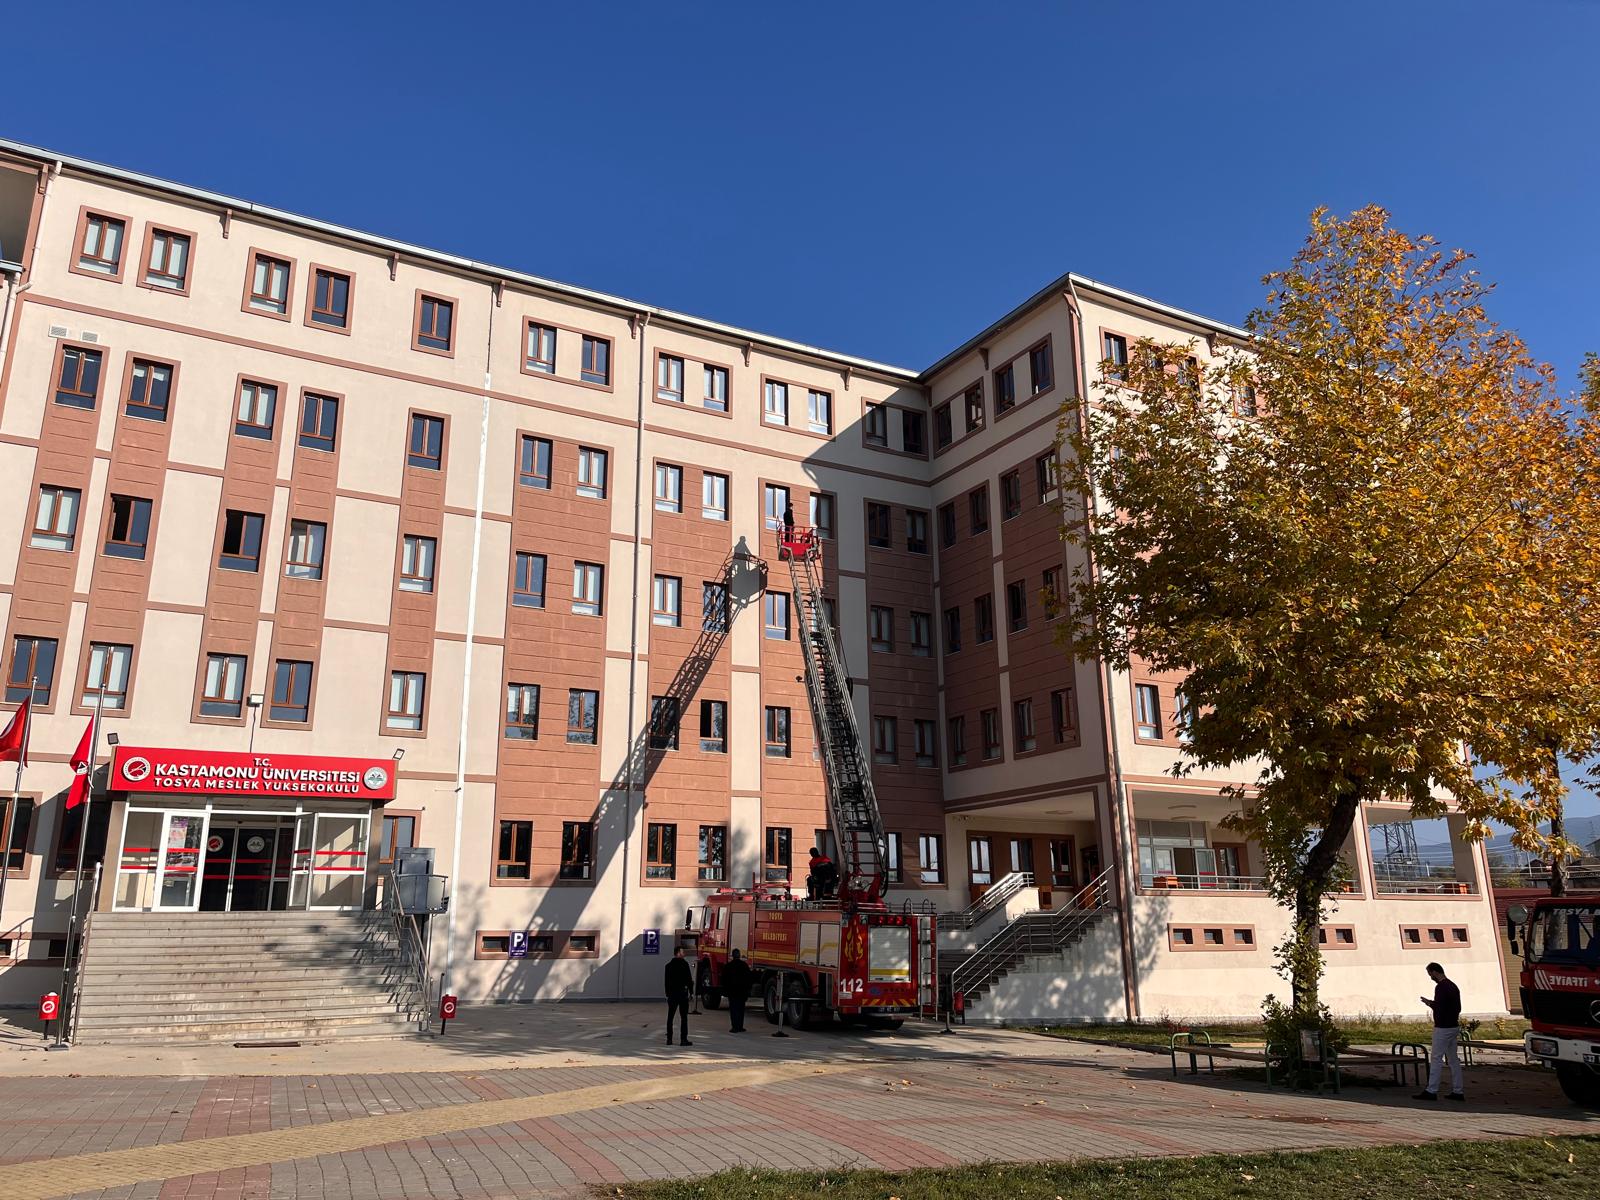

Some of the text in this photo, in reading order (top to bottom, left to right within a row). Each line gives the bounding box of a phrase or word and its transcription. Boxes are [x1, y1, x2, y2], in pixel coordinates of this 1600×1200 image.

[254, 757, 272, 767] T.C.
[155, 763, 258, 779] KASTAMONU
[154, 777, 201, 788] TOSYA
[205, 779, 259, 790] MESLEK
[513, 932, 524, 948] P
[647, 931, 656, 945] P
[840, 977, 864, 993] 112
